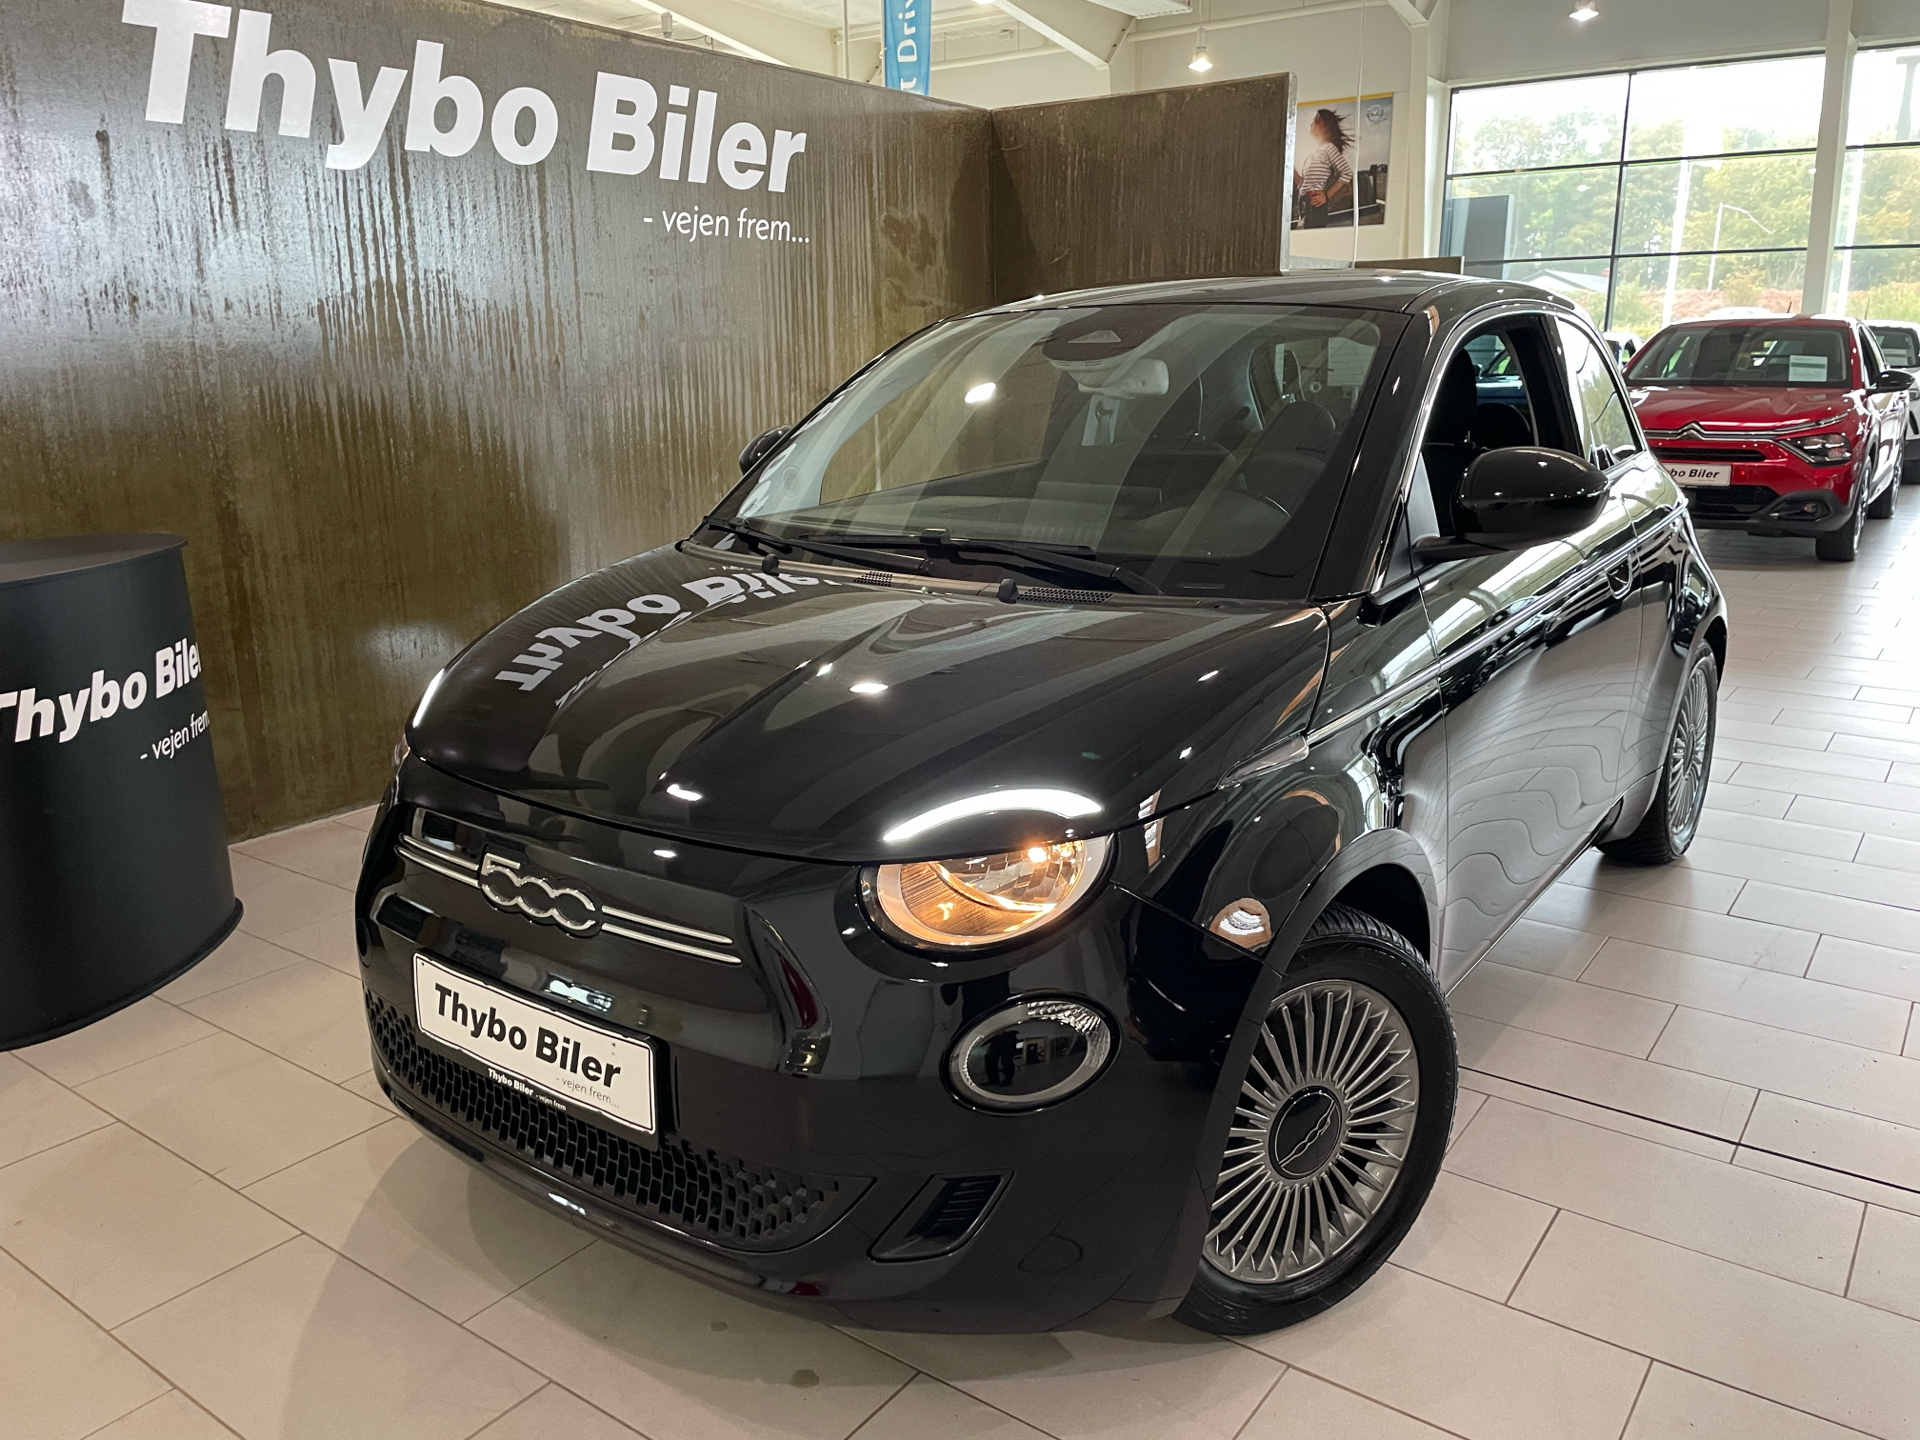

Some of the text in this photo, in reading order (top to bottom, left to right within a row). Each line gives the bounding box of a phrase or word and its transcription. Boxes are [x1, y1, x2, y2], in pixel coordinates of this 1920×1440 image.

[122, 0, 806, 193] Thybo Biler
[662, 205, 730, 243] vejen
[737, 207, 810, 244] frem...
[1688, 468, 1720, 479] Biler
[152, 728, 189, 760] vejen
[481, 852, 596, 931] 500
[434, 982, 622, 1089] Thybo Biler
[487, 1068, 513, 1087] Thybo
[513, 1079, 534, 1097] Biler
[562, 1077, 587, 1094] vejen
[589, 1086, 620, 1109] frem...
